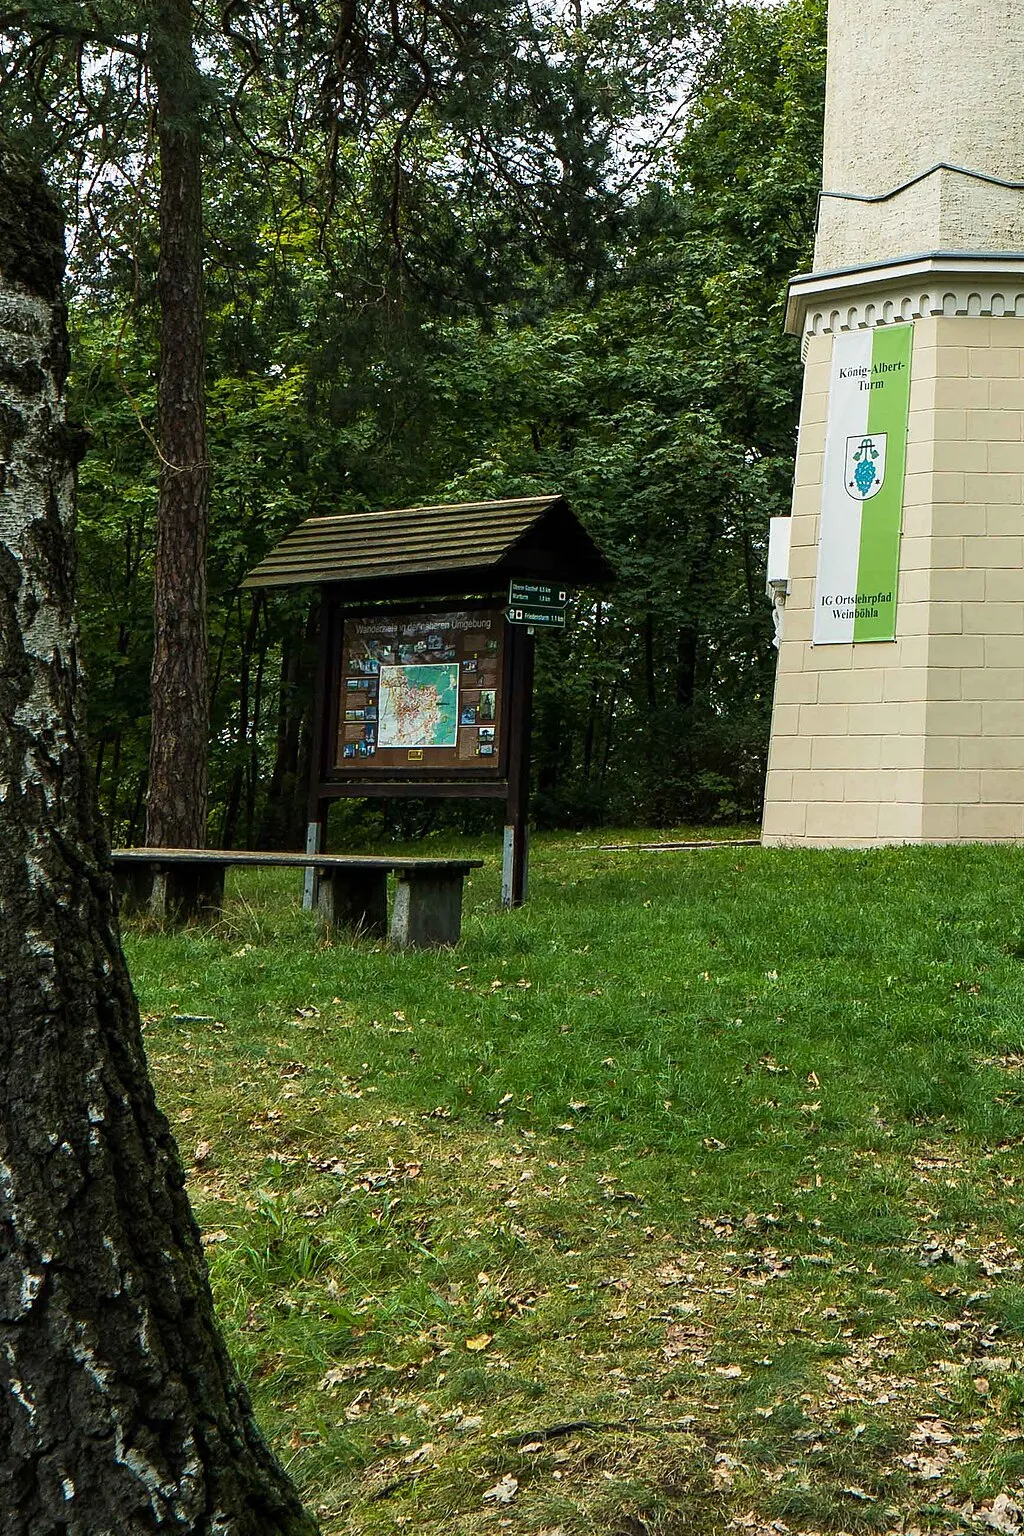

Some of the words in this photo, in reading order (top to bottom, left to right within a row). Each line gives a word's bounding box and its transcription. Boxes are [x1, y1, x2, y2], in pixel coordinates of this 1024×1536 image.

[839, 361, 905, 379] König-Albert-
[858, 380, 884, 391] Turm
[821, 595, 833, 606] IG
[835, 591, 892, 606] Ortslehrpfad
[832, 607, 879, 619] Weinböhla
[451, 618, 491, 631] Umgebung
